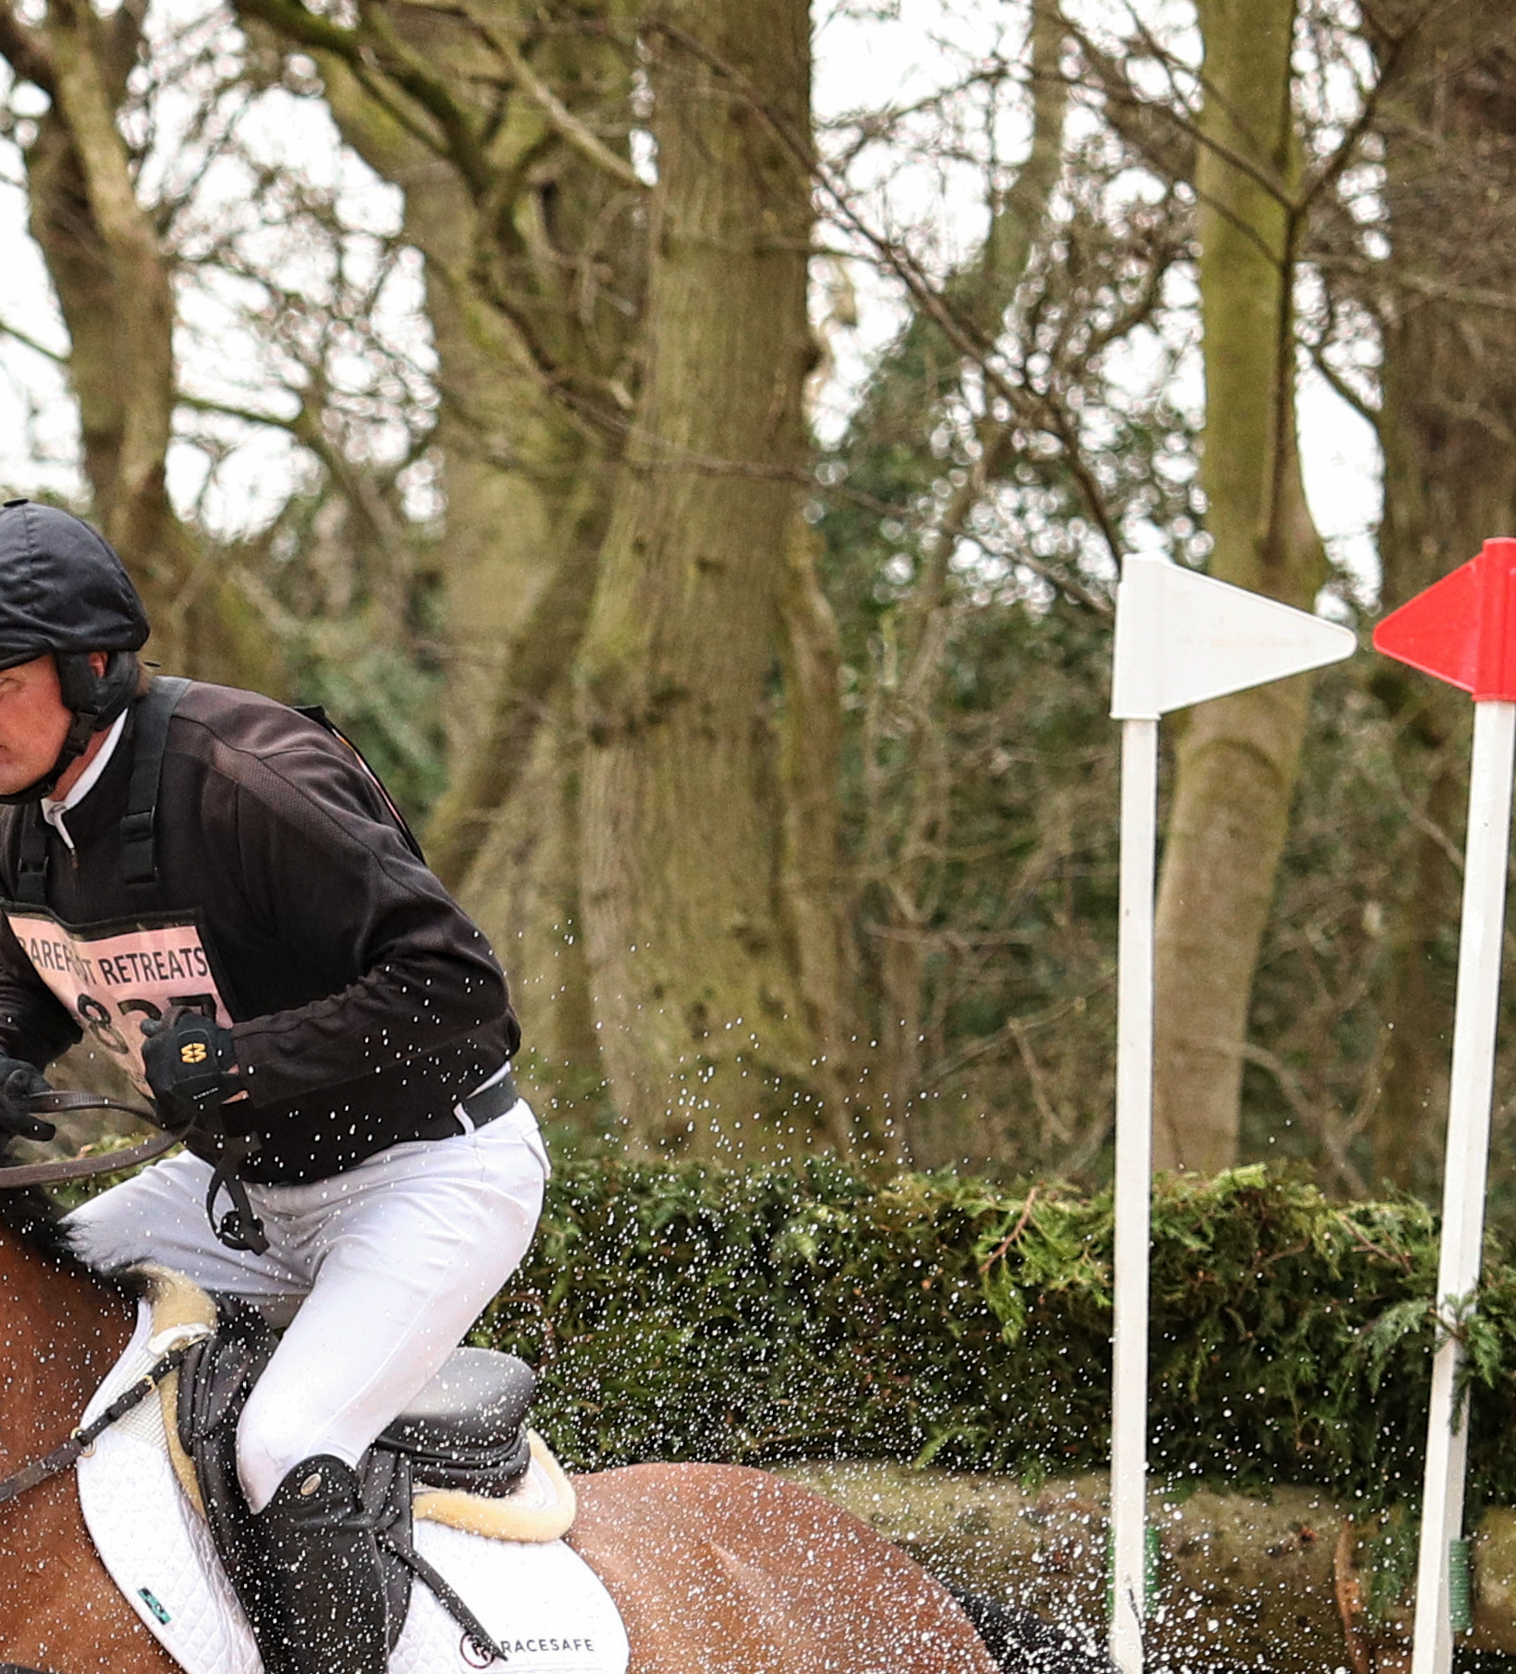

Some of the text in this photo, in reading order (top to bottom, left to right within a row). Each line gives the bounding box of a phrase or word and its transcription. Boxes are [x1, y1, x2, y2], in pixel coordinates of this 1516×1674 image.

[16, 936, 208, 985] AREFT RETREATS
[501, 1639, 595, 1653] RACESAFE
